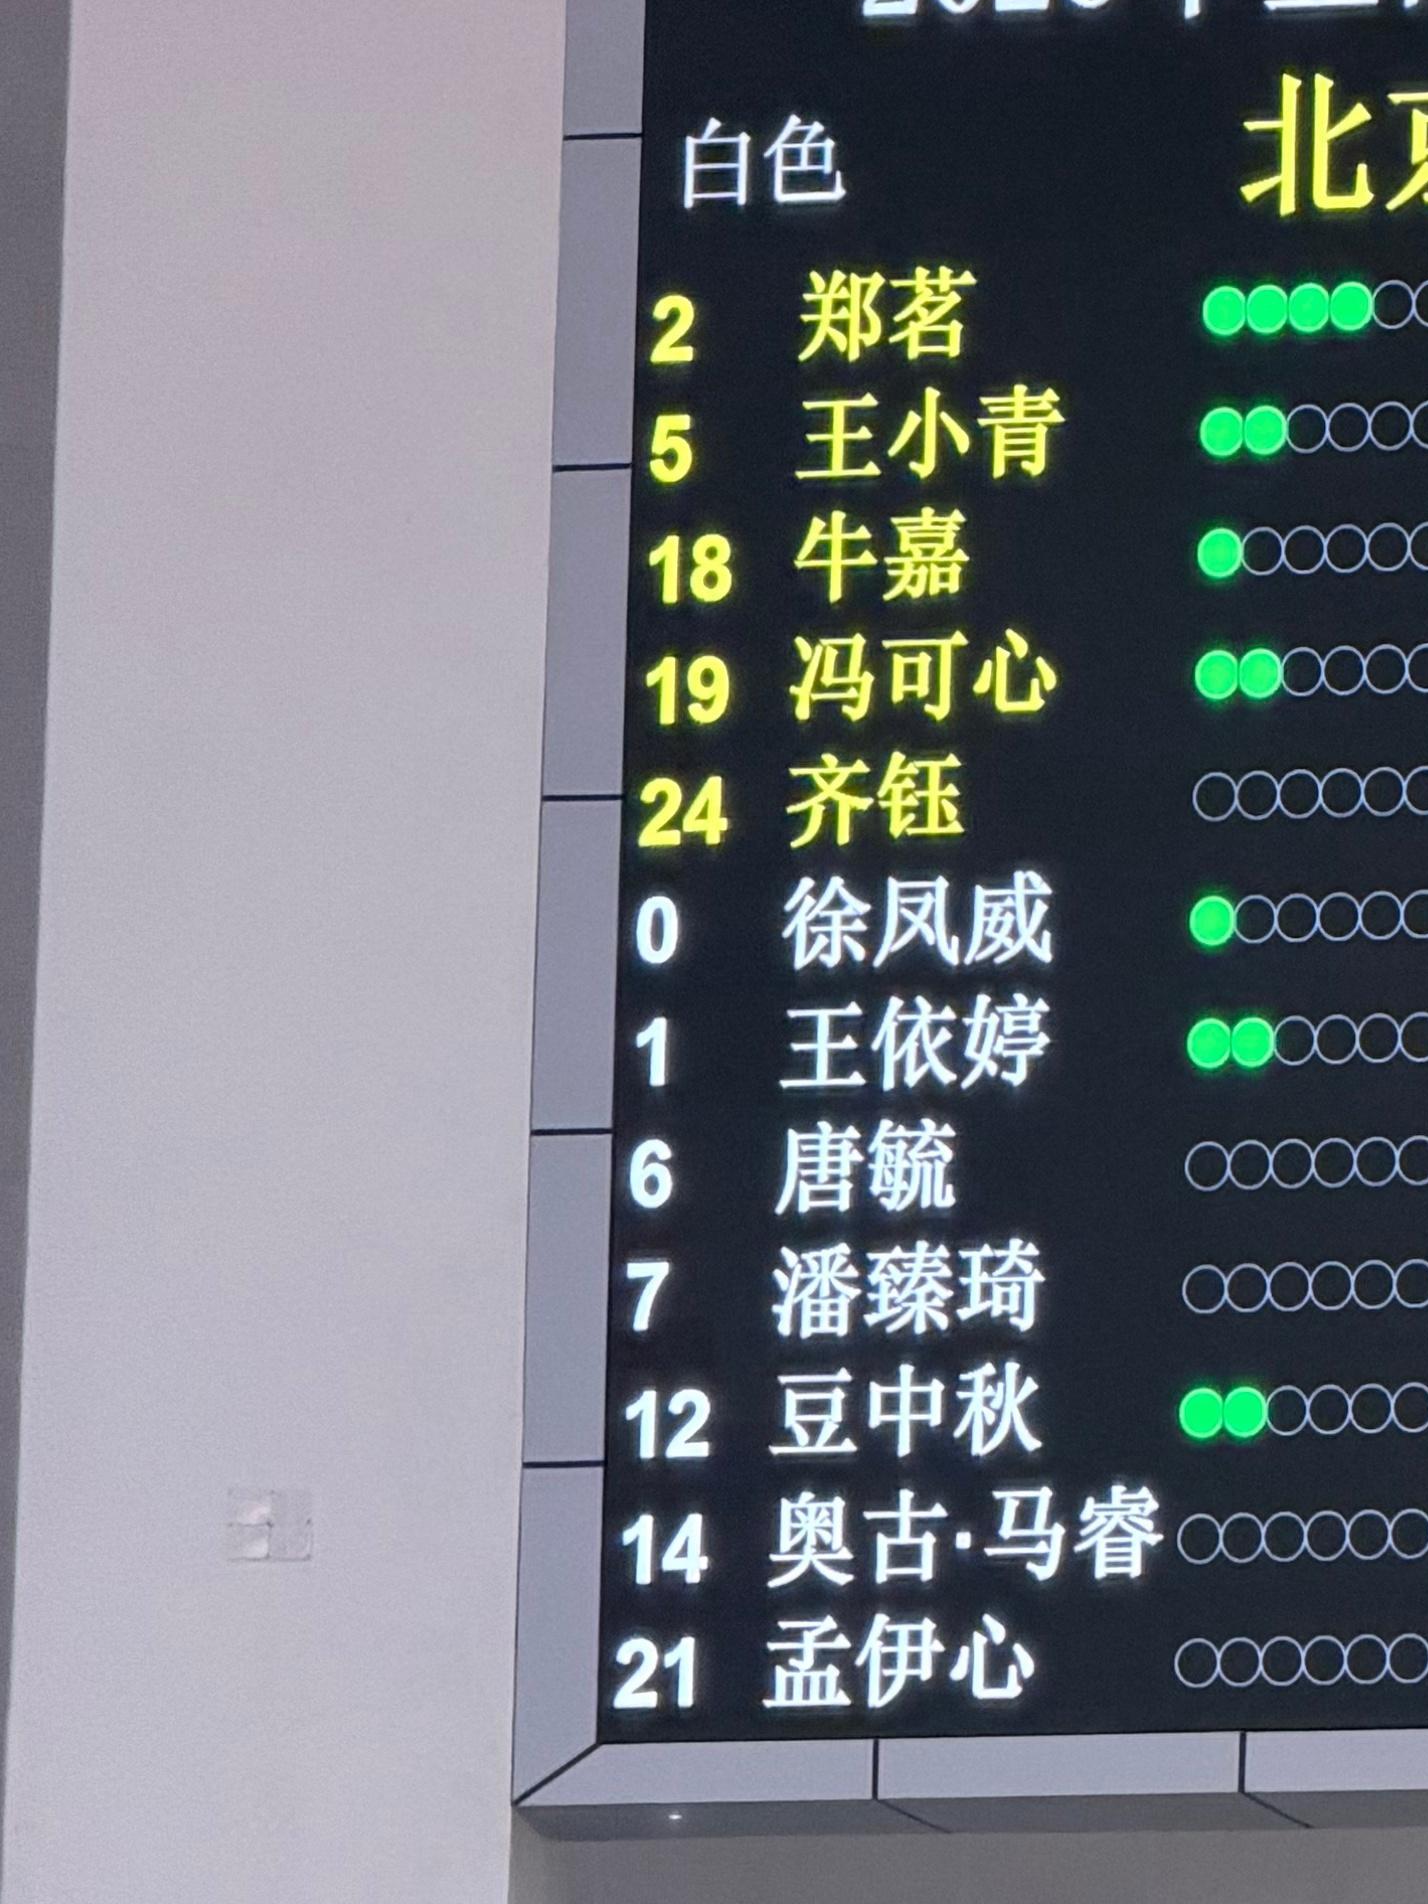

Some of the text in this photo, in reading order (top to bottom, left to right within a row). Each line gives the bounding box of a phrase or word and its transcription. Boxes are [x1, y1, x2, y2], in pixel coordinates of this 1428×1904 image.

[684, 114, 846, 209] 白色
[650, 294, 695, 364] 2
[798, 266, 977, 362] 郑茗
[649, 414, 693, 483] 5
[795, 384, 1065, 479] 王小青
[649, 533, 732, 604] 18
[794, 506, 970, 603] 牛嘉
[646, 655, 730, 725] 19
[789, 628, 1057, 722] 冯可心
[638, 776, 729, 848] 24
[786, 750, 964, 848] 齐钰
[635, 895, 680, 966] 0
[782, 870, 1053, 971] 徐凤威
[635, 1017, 668, 1087] 1
[779, 992, 1051, 1092] 王依婷
[629, 1138, 674, 1209] 6
[774, 1117, 956, 1215] 唐毓
[627, 1258, 671, 1332] 7
[771, 1237, 1046, 1340] 潘臻琦
[624, 1387, 711, 1460] 12
[769, 1358, 1042, 1458] 豆中秋
[621, 1512, 710, 1585] 14
[616, 1634, 697, 1709] 21
[762, 1612, 1035, 1709] 孟伊心
